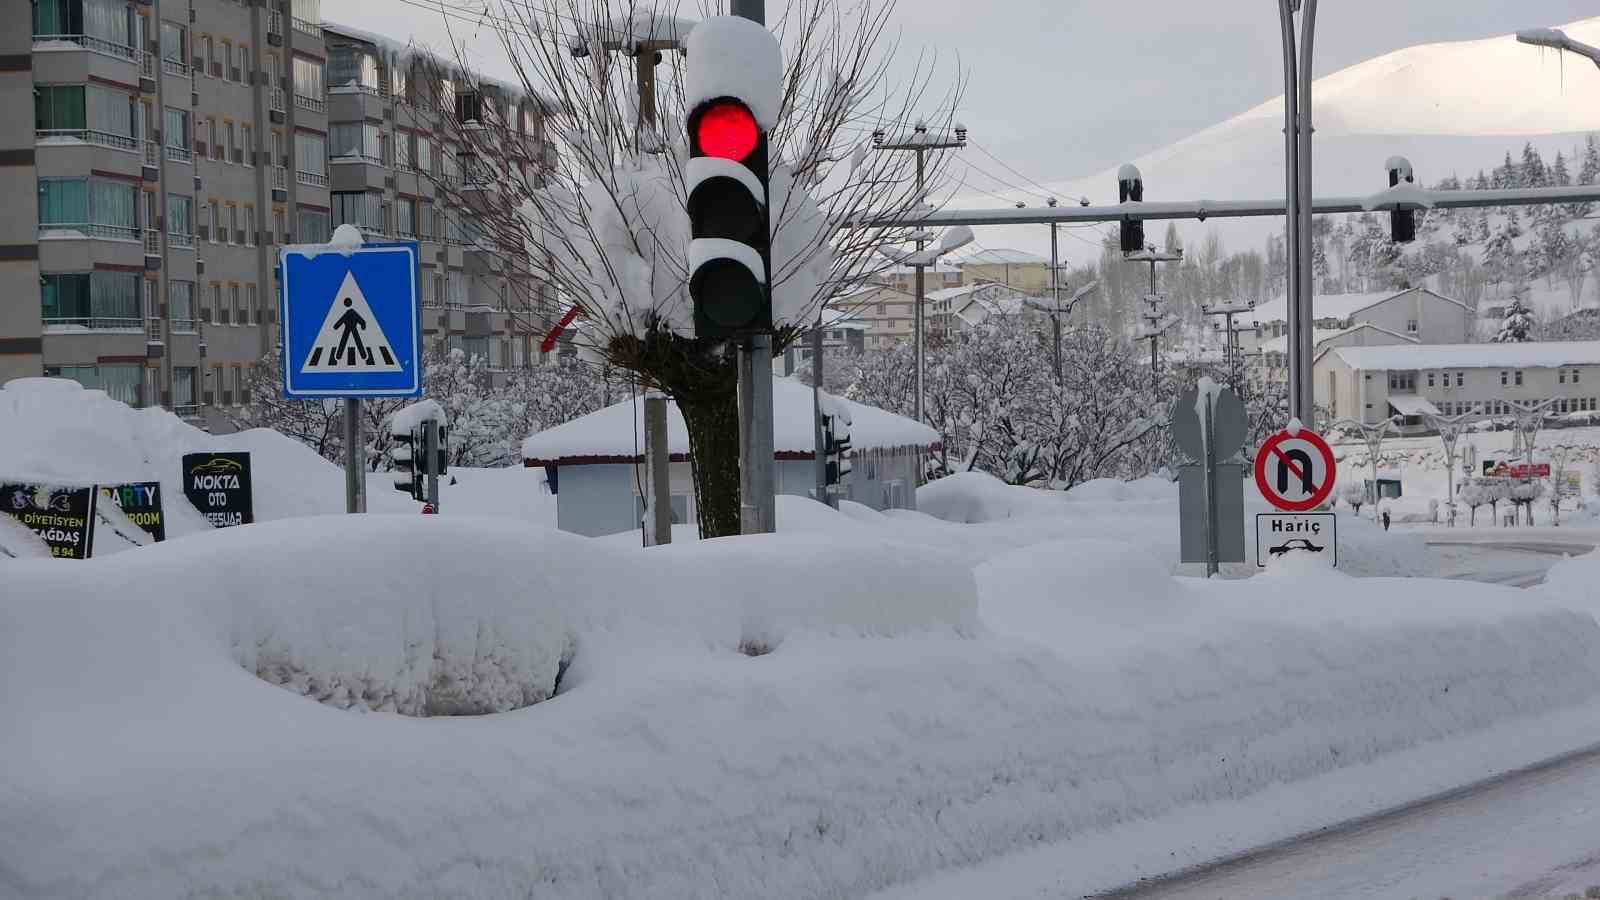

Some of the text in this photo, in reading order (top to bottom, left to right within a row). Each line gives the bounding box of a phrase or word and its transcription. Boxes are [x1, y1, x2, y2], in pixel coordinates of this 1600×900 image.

[193, 474, 240, 489] NOKTA
[208, 492, 227, 506] OTO
[24, 512, 83, 527] DİYETİSYEN
[1272, 520, 1321, 535] Hariç
